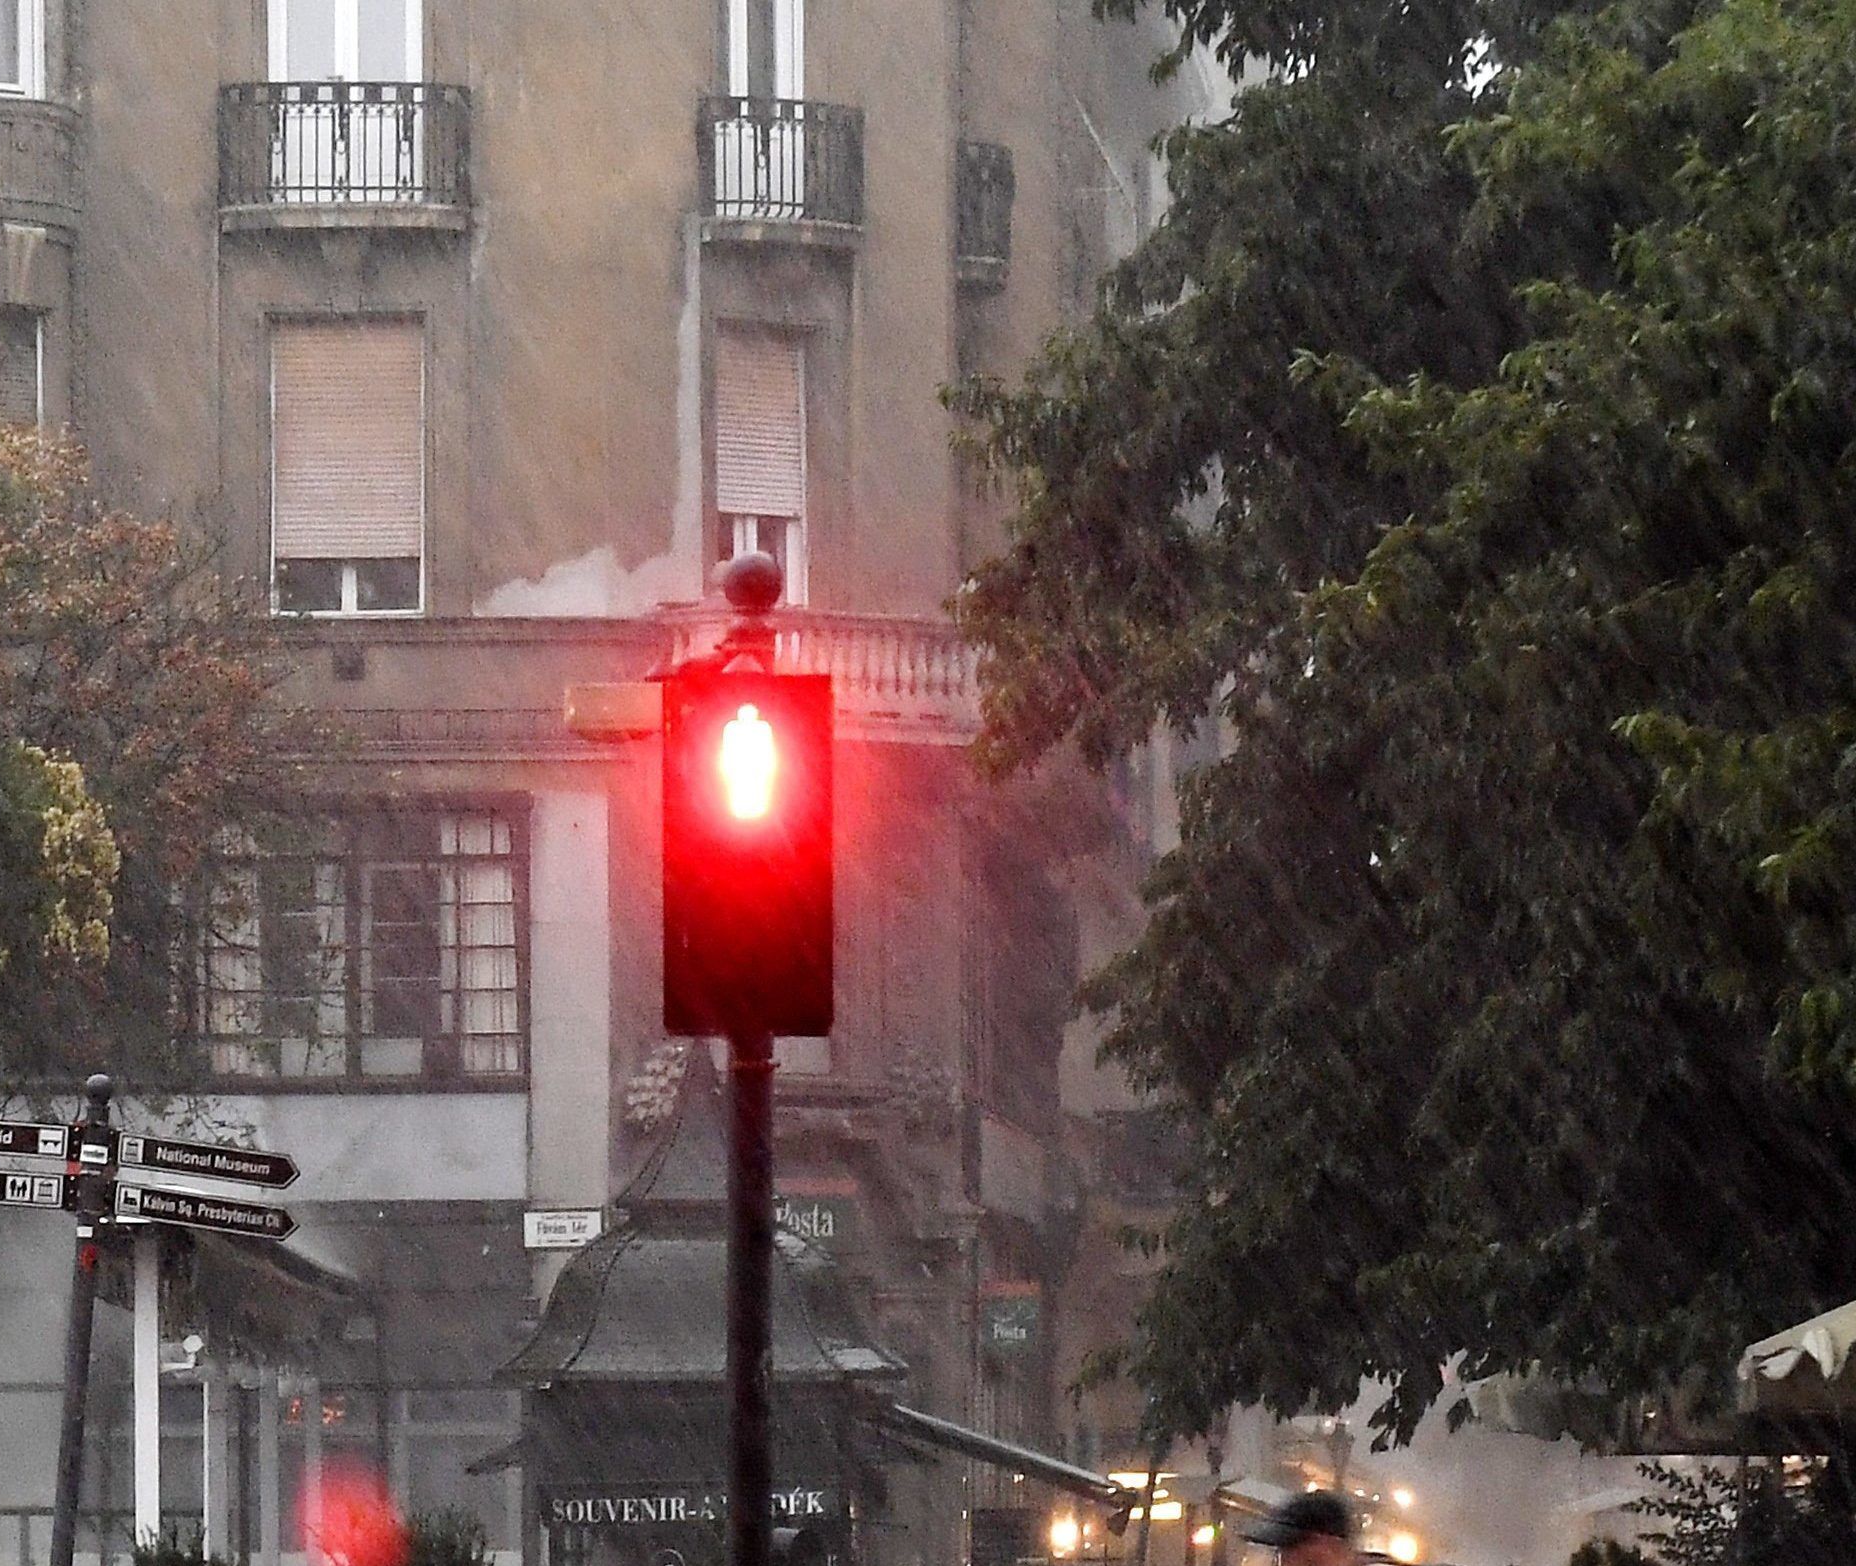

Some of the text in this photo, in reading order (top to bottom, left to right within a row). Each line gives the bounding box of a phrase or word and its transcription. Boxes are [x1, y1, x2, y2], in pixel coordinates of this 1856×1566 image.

[156, 1146, 270, 1176] National Museum
[197, 1203, 264, 1225] Presbyterian
[775, 1202, 834, 1237] Posta
